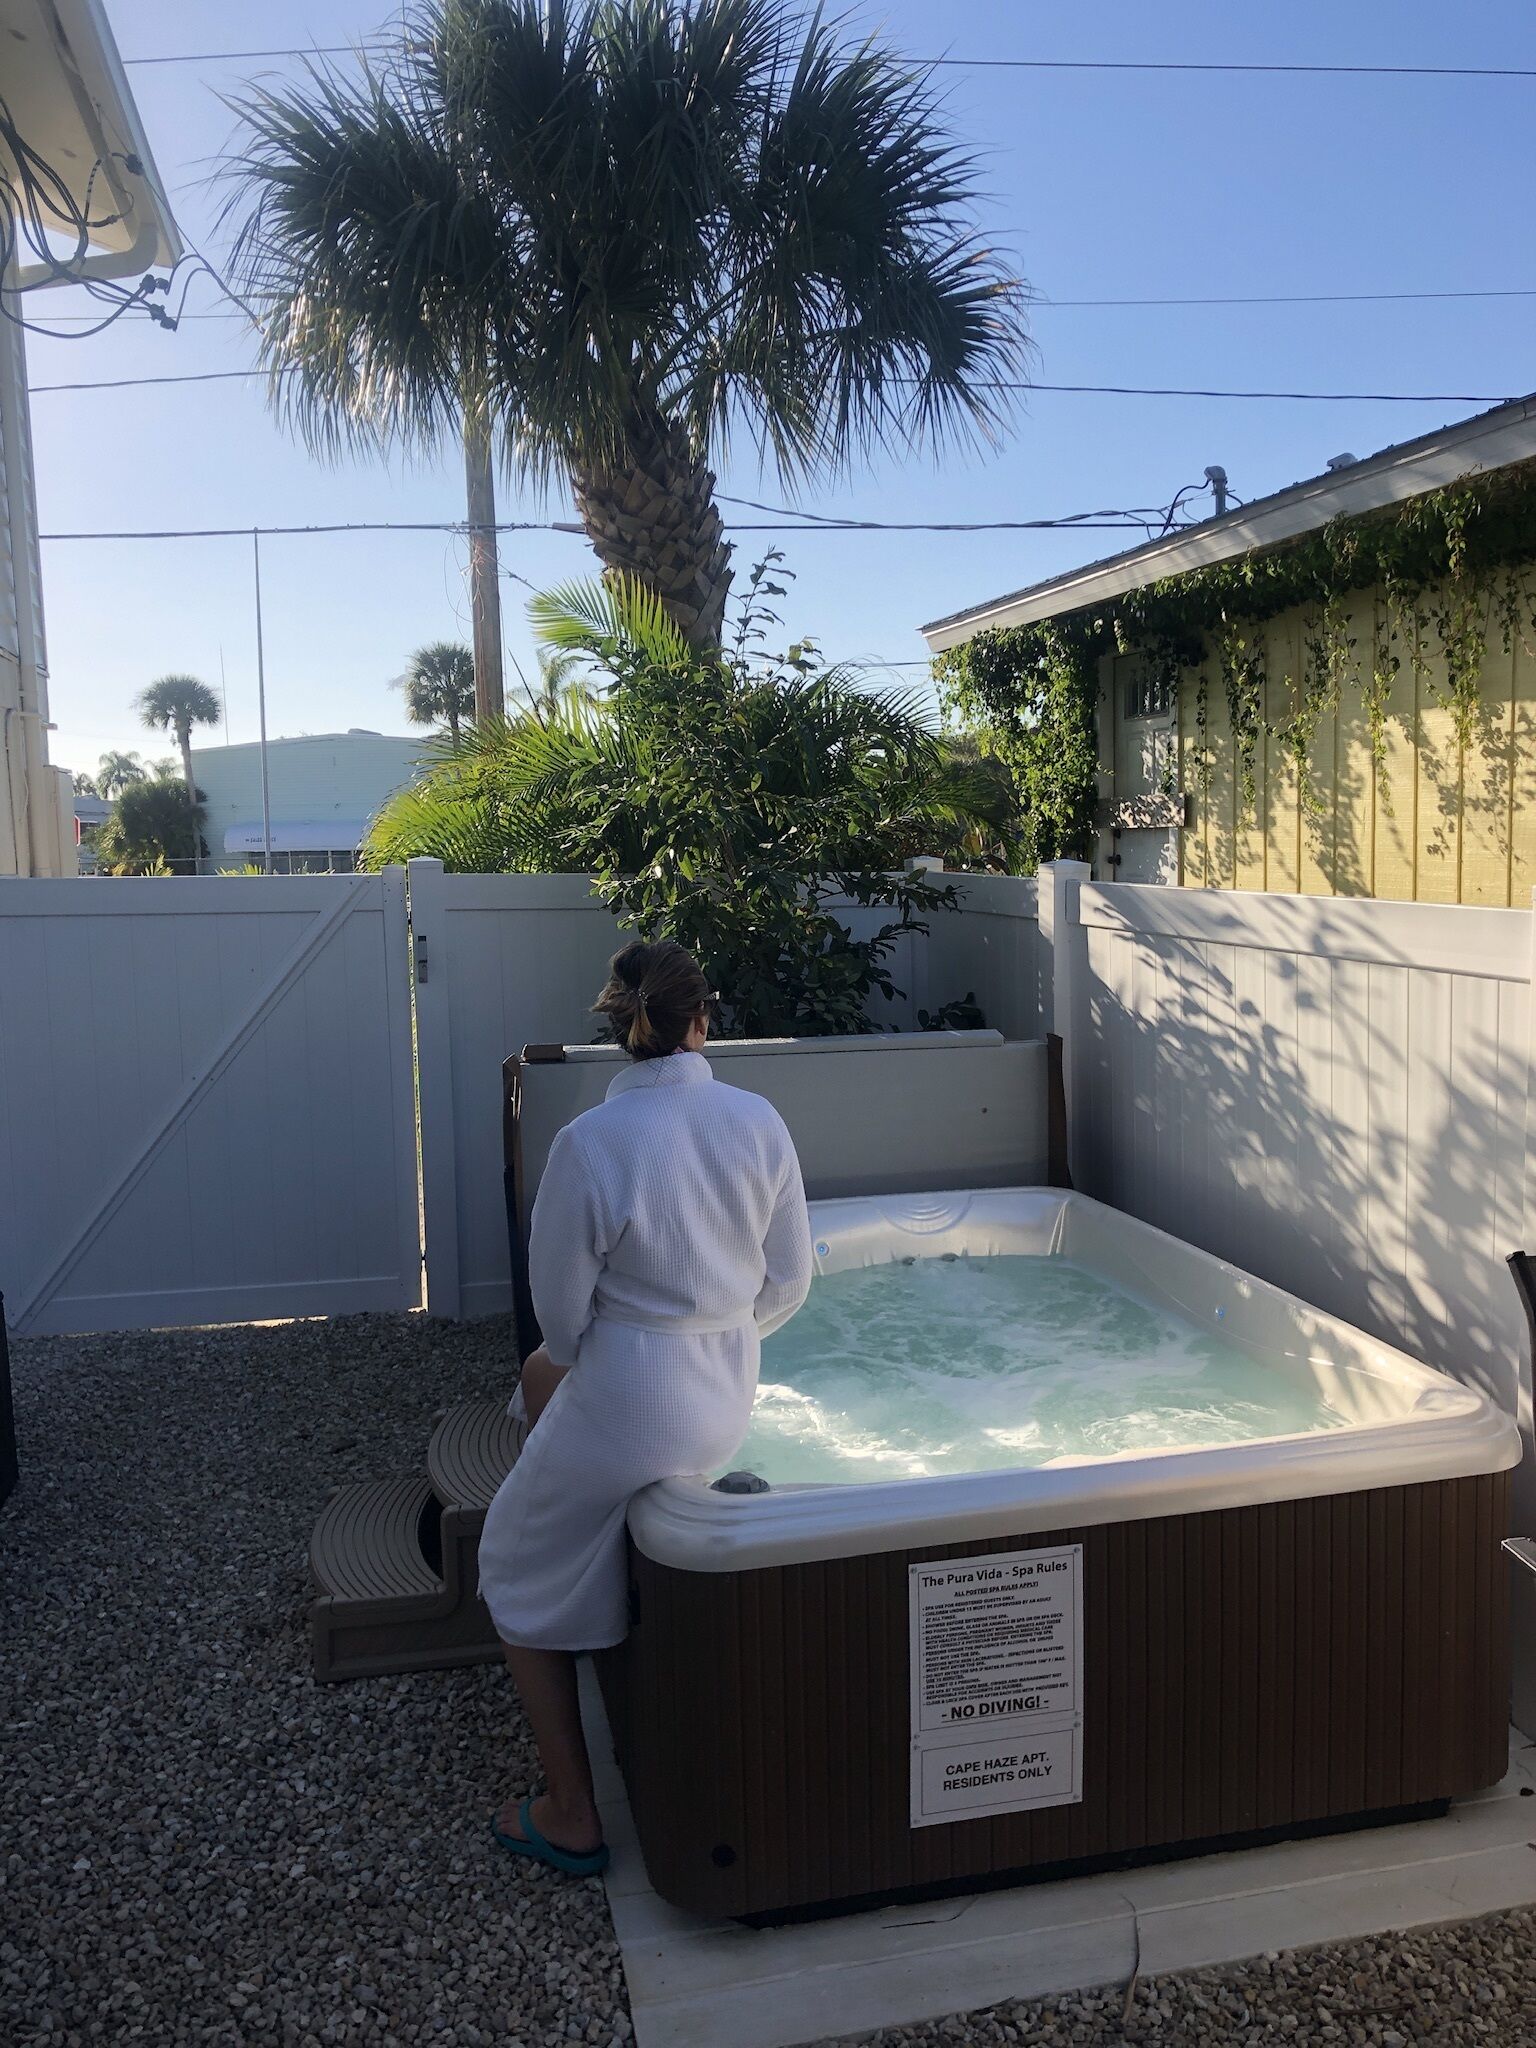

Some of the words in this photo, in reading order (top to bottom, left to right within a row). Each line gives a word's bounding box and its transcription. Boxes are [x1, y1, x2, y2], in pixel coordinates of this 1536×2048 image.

[922, 1576, 944, 1587] The
[947, 1574, 973, 1584] Pura
[977, 1569, 1002, 1581] Vida
[1012, 1566, 1033, 1578] Spa
[1037, 1562, 1067, 1573] Rules
[951, 1705, 974, 1719] NO
[979, 1696, 1040, 1715] DIVING!
[946, 1761, 980, 1775] CAPE
[985, 1756, 1018, 1770] HAZE
[1022, 1752, 1049, 1764] APT.
[944, 1772, 1014, 1790] RESIDENTS
[1018, 1766, 1052, 1779] ONLY
